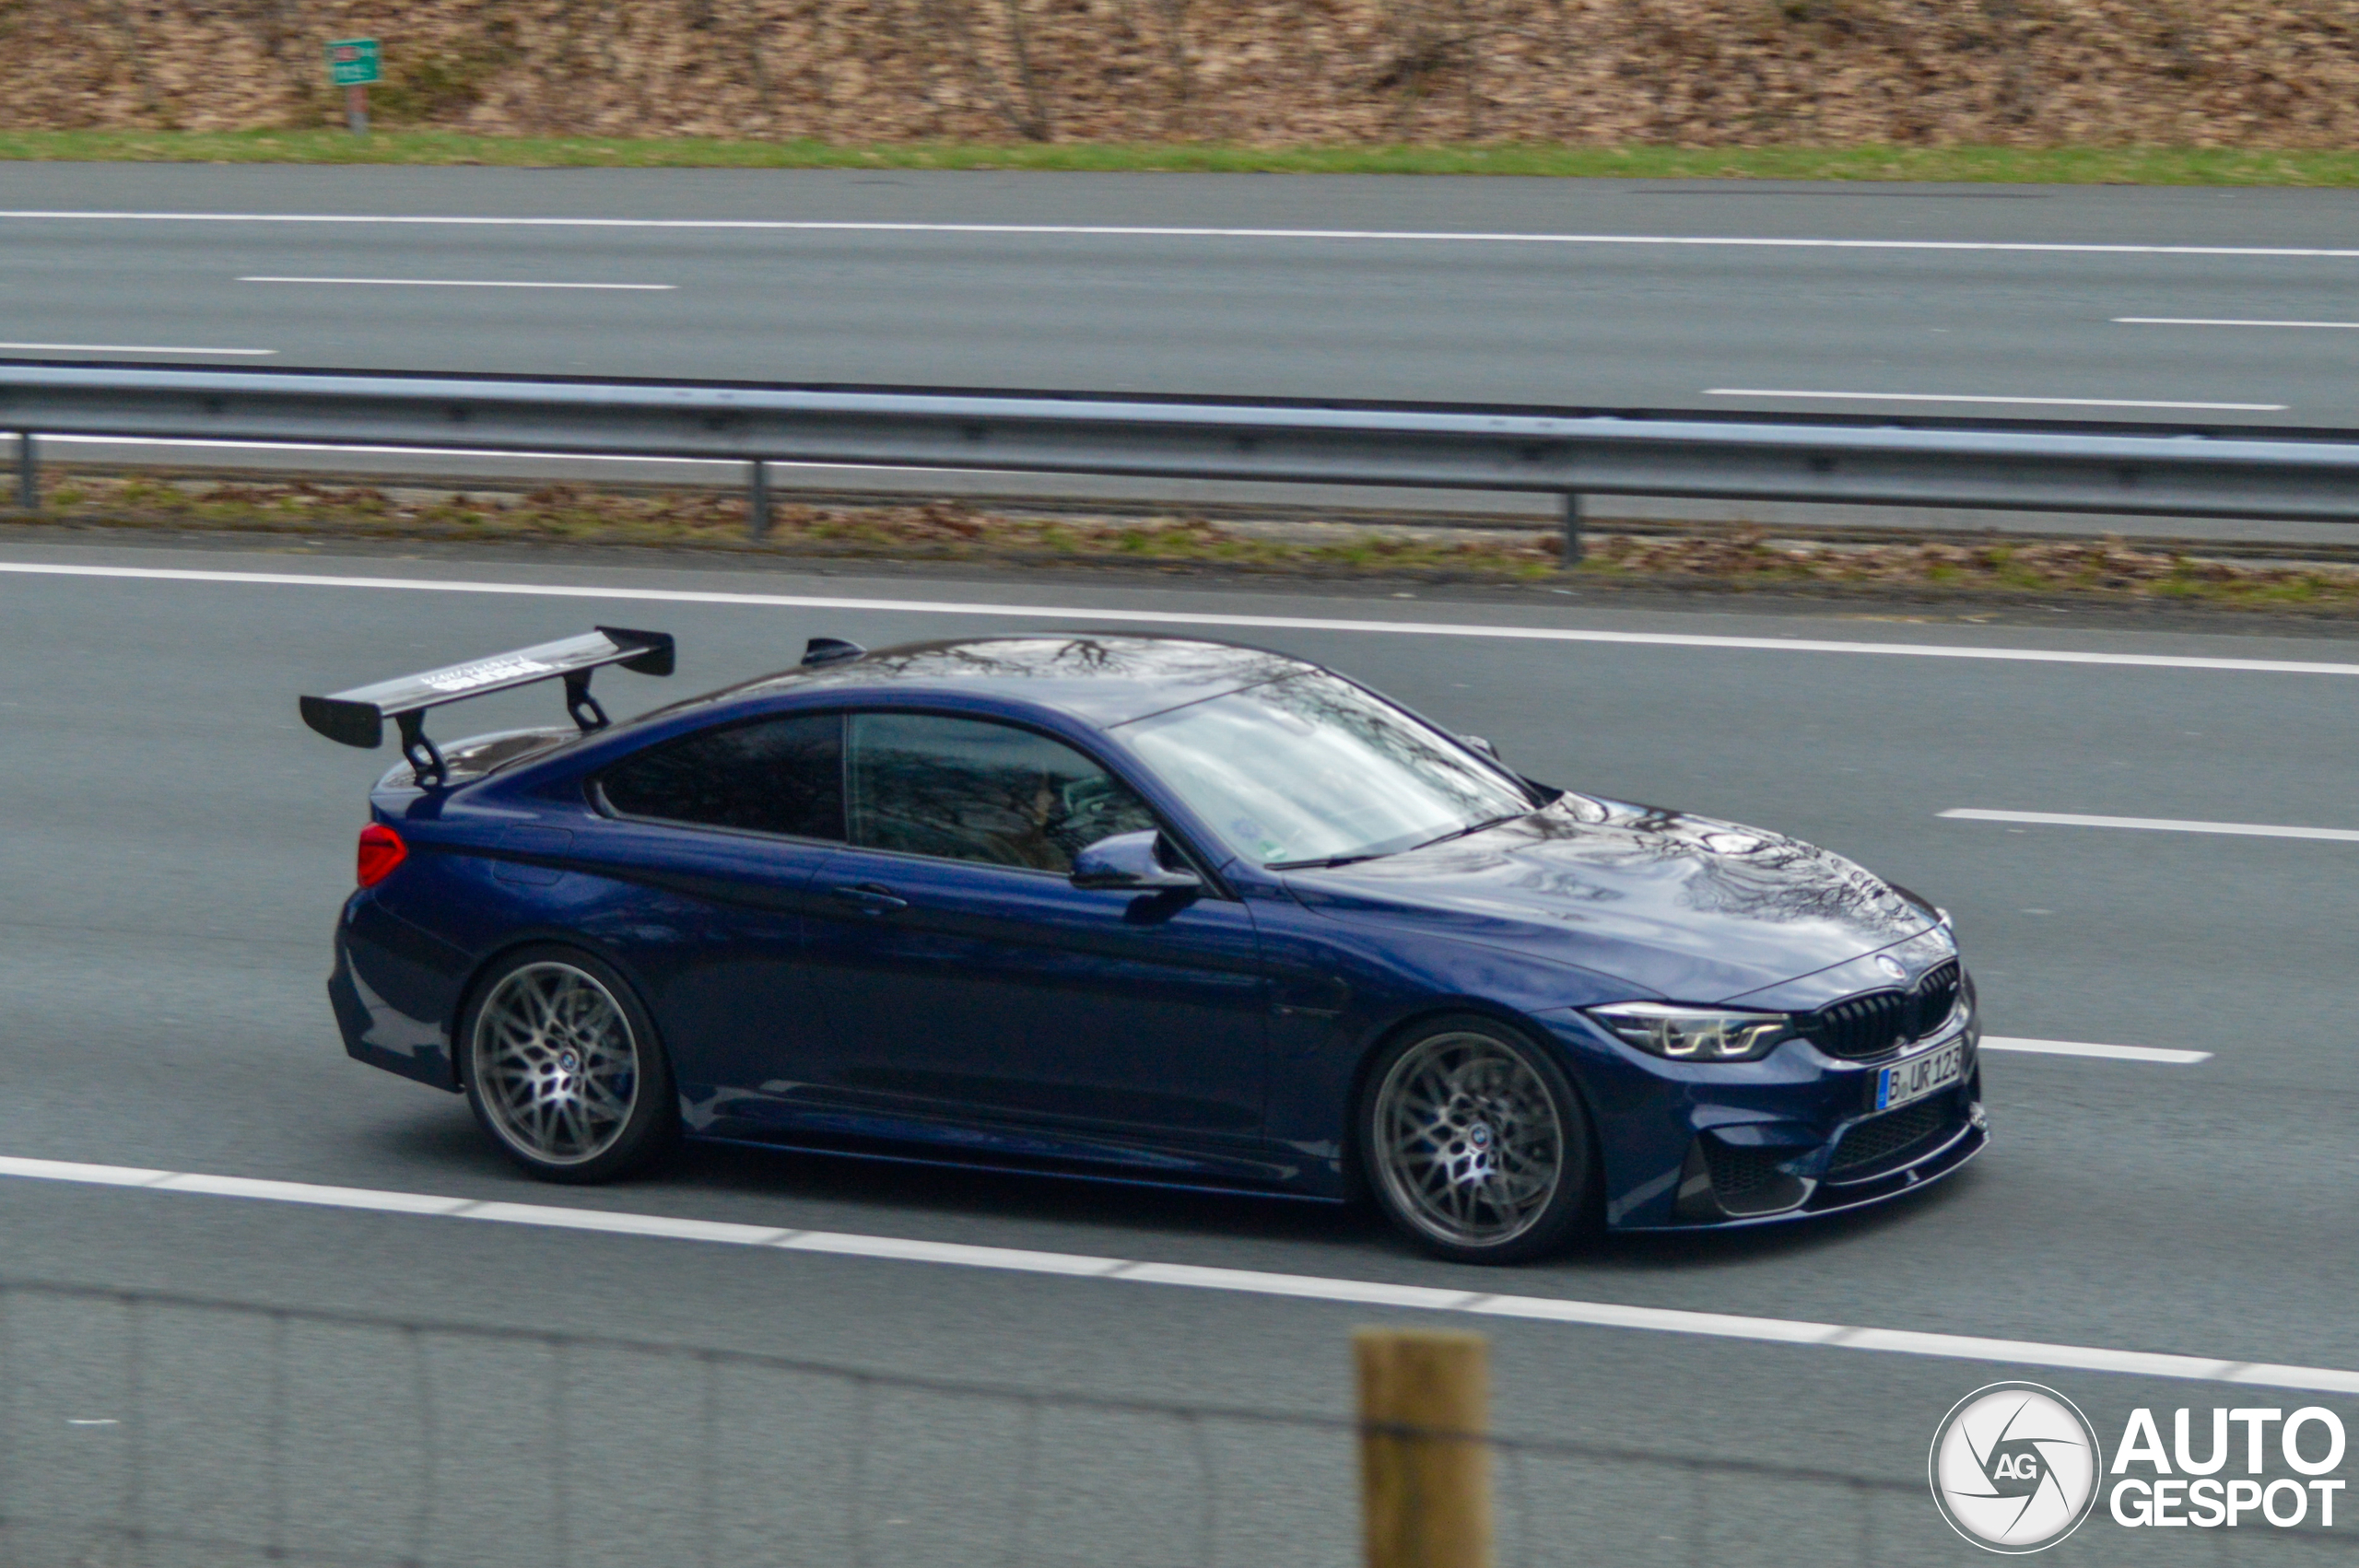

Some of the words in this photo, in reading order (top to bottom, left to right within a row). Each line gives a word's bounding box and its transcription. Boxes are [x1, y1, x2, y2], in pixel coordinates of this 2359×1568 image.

[1890, 1071, 1900, 1100] B
[1911, 1059, 1931, 1092] UR
[1933, 1047, 1959, 1083] 123
